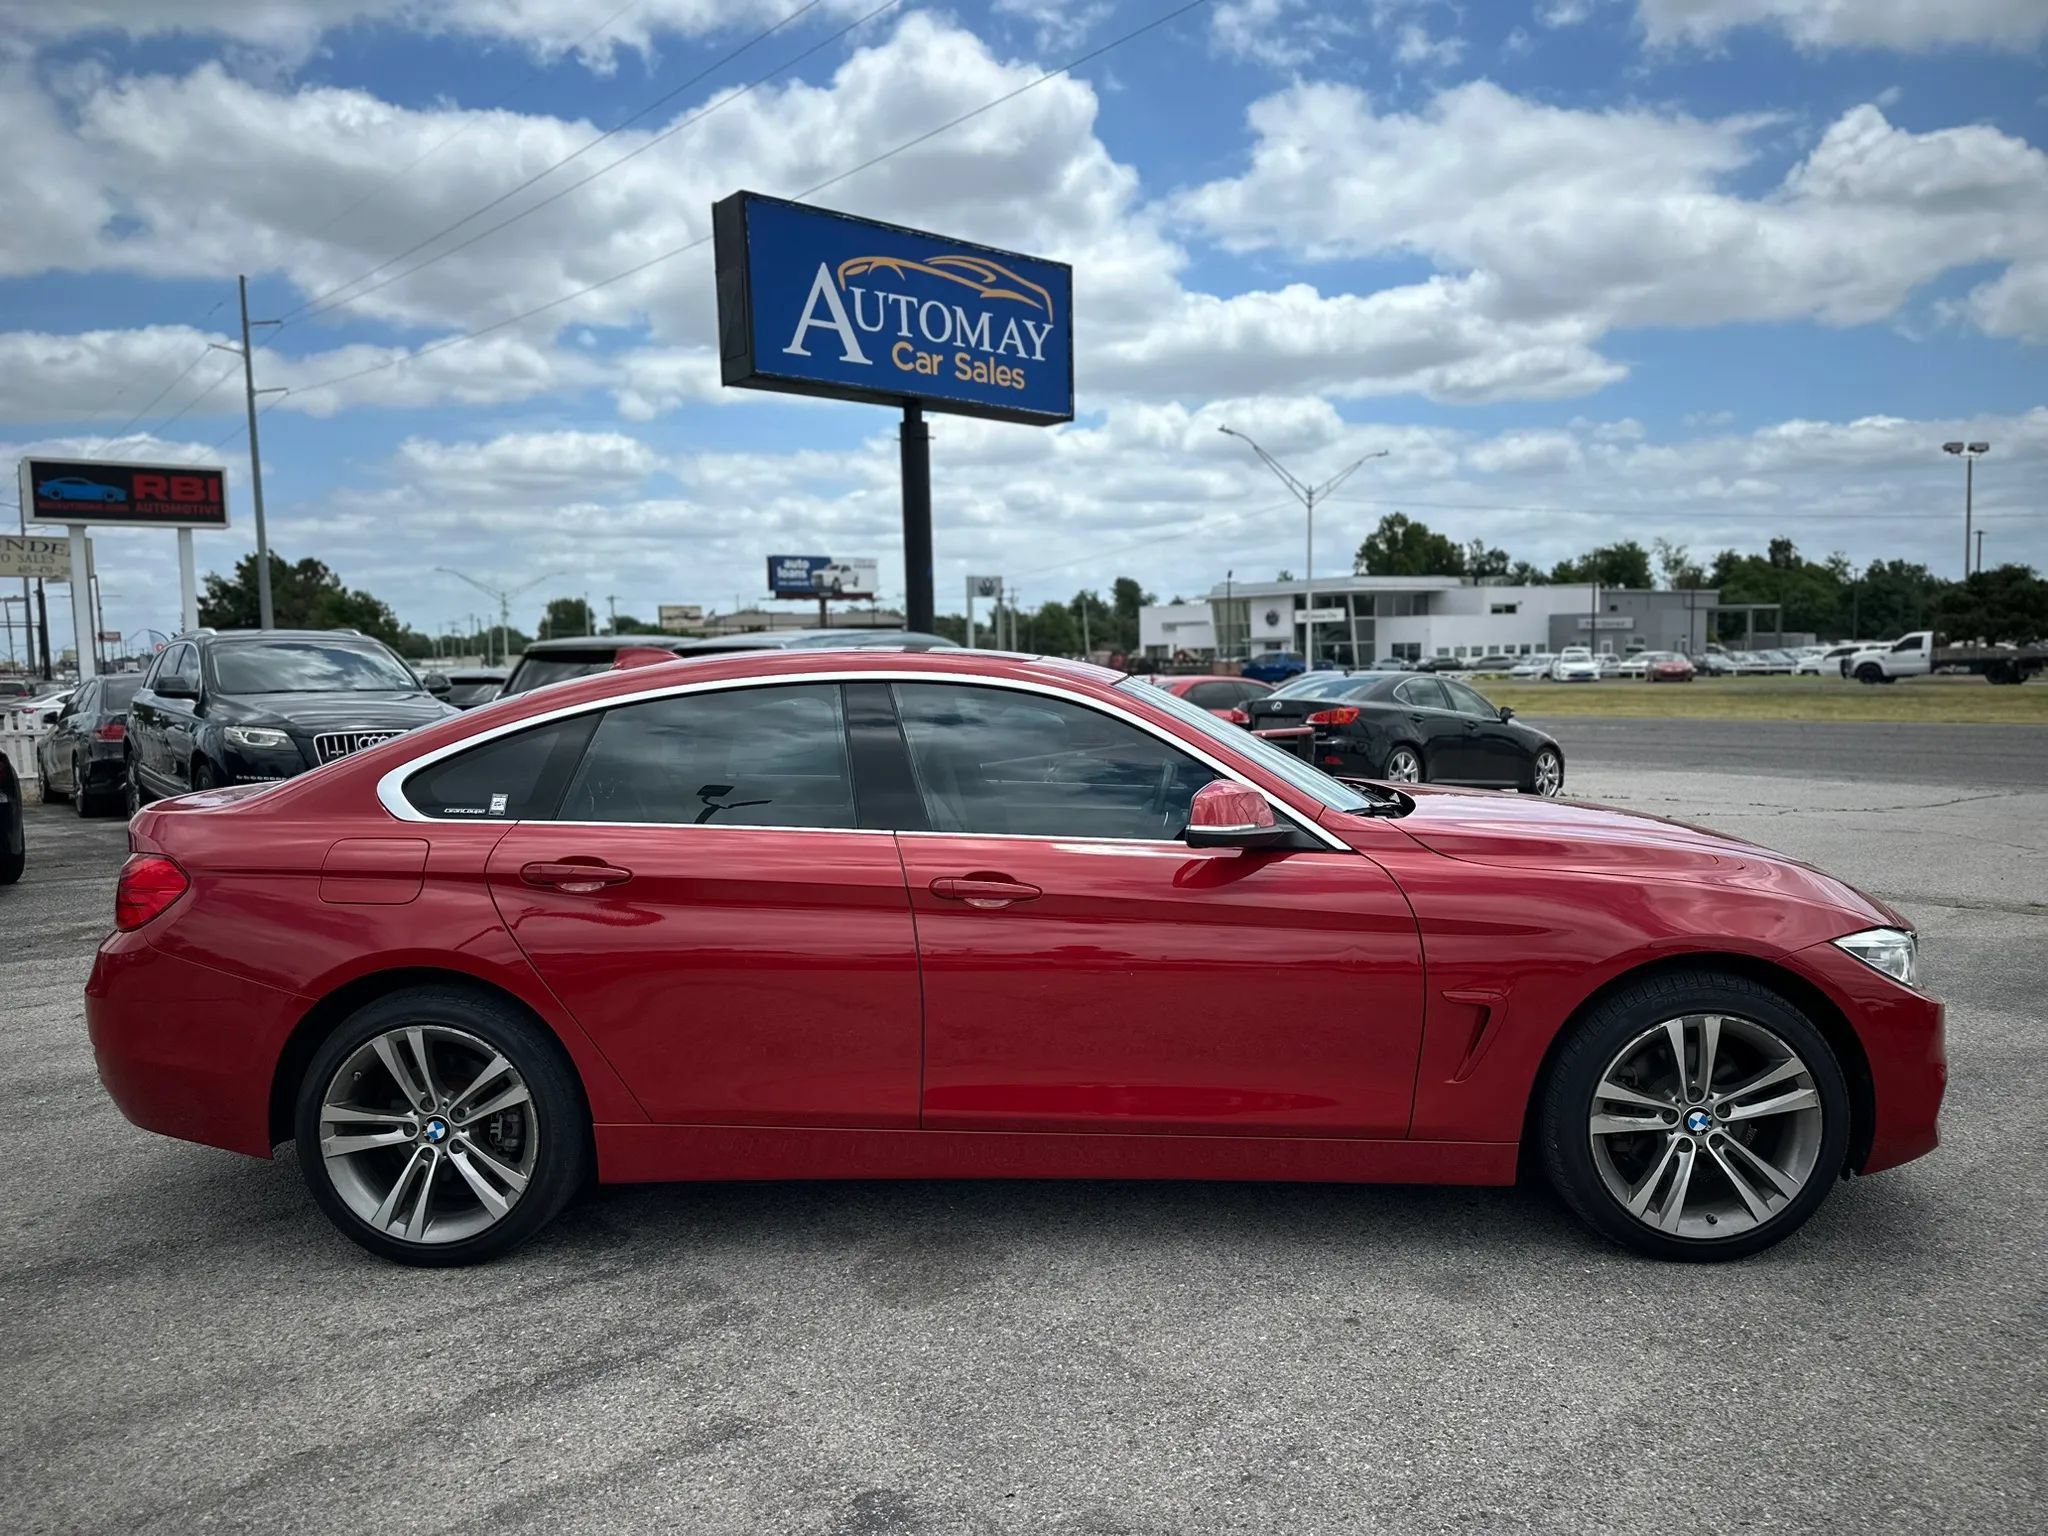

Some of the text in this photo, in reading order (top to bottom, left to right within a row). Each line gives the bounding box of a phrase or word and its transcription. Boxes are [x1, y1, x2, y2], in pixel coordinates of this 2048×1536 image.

[782, 262, 1054, 365] AUTOMAY
[892, 342, 1025, 389] Car Sales
[133, 475, 219, 502] RBI
[135, 502, 219, 515] AUTOMOTIVE
